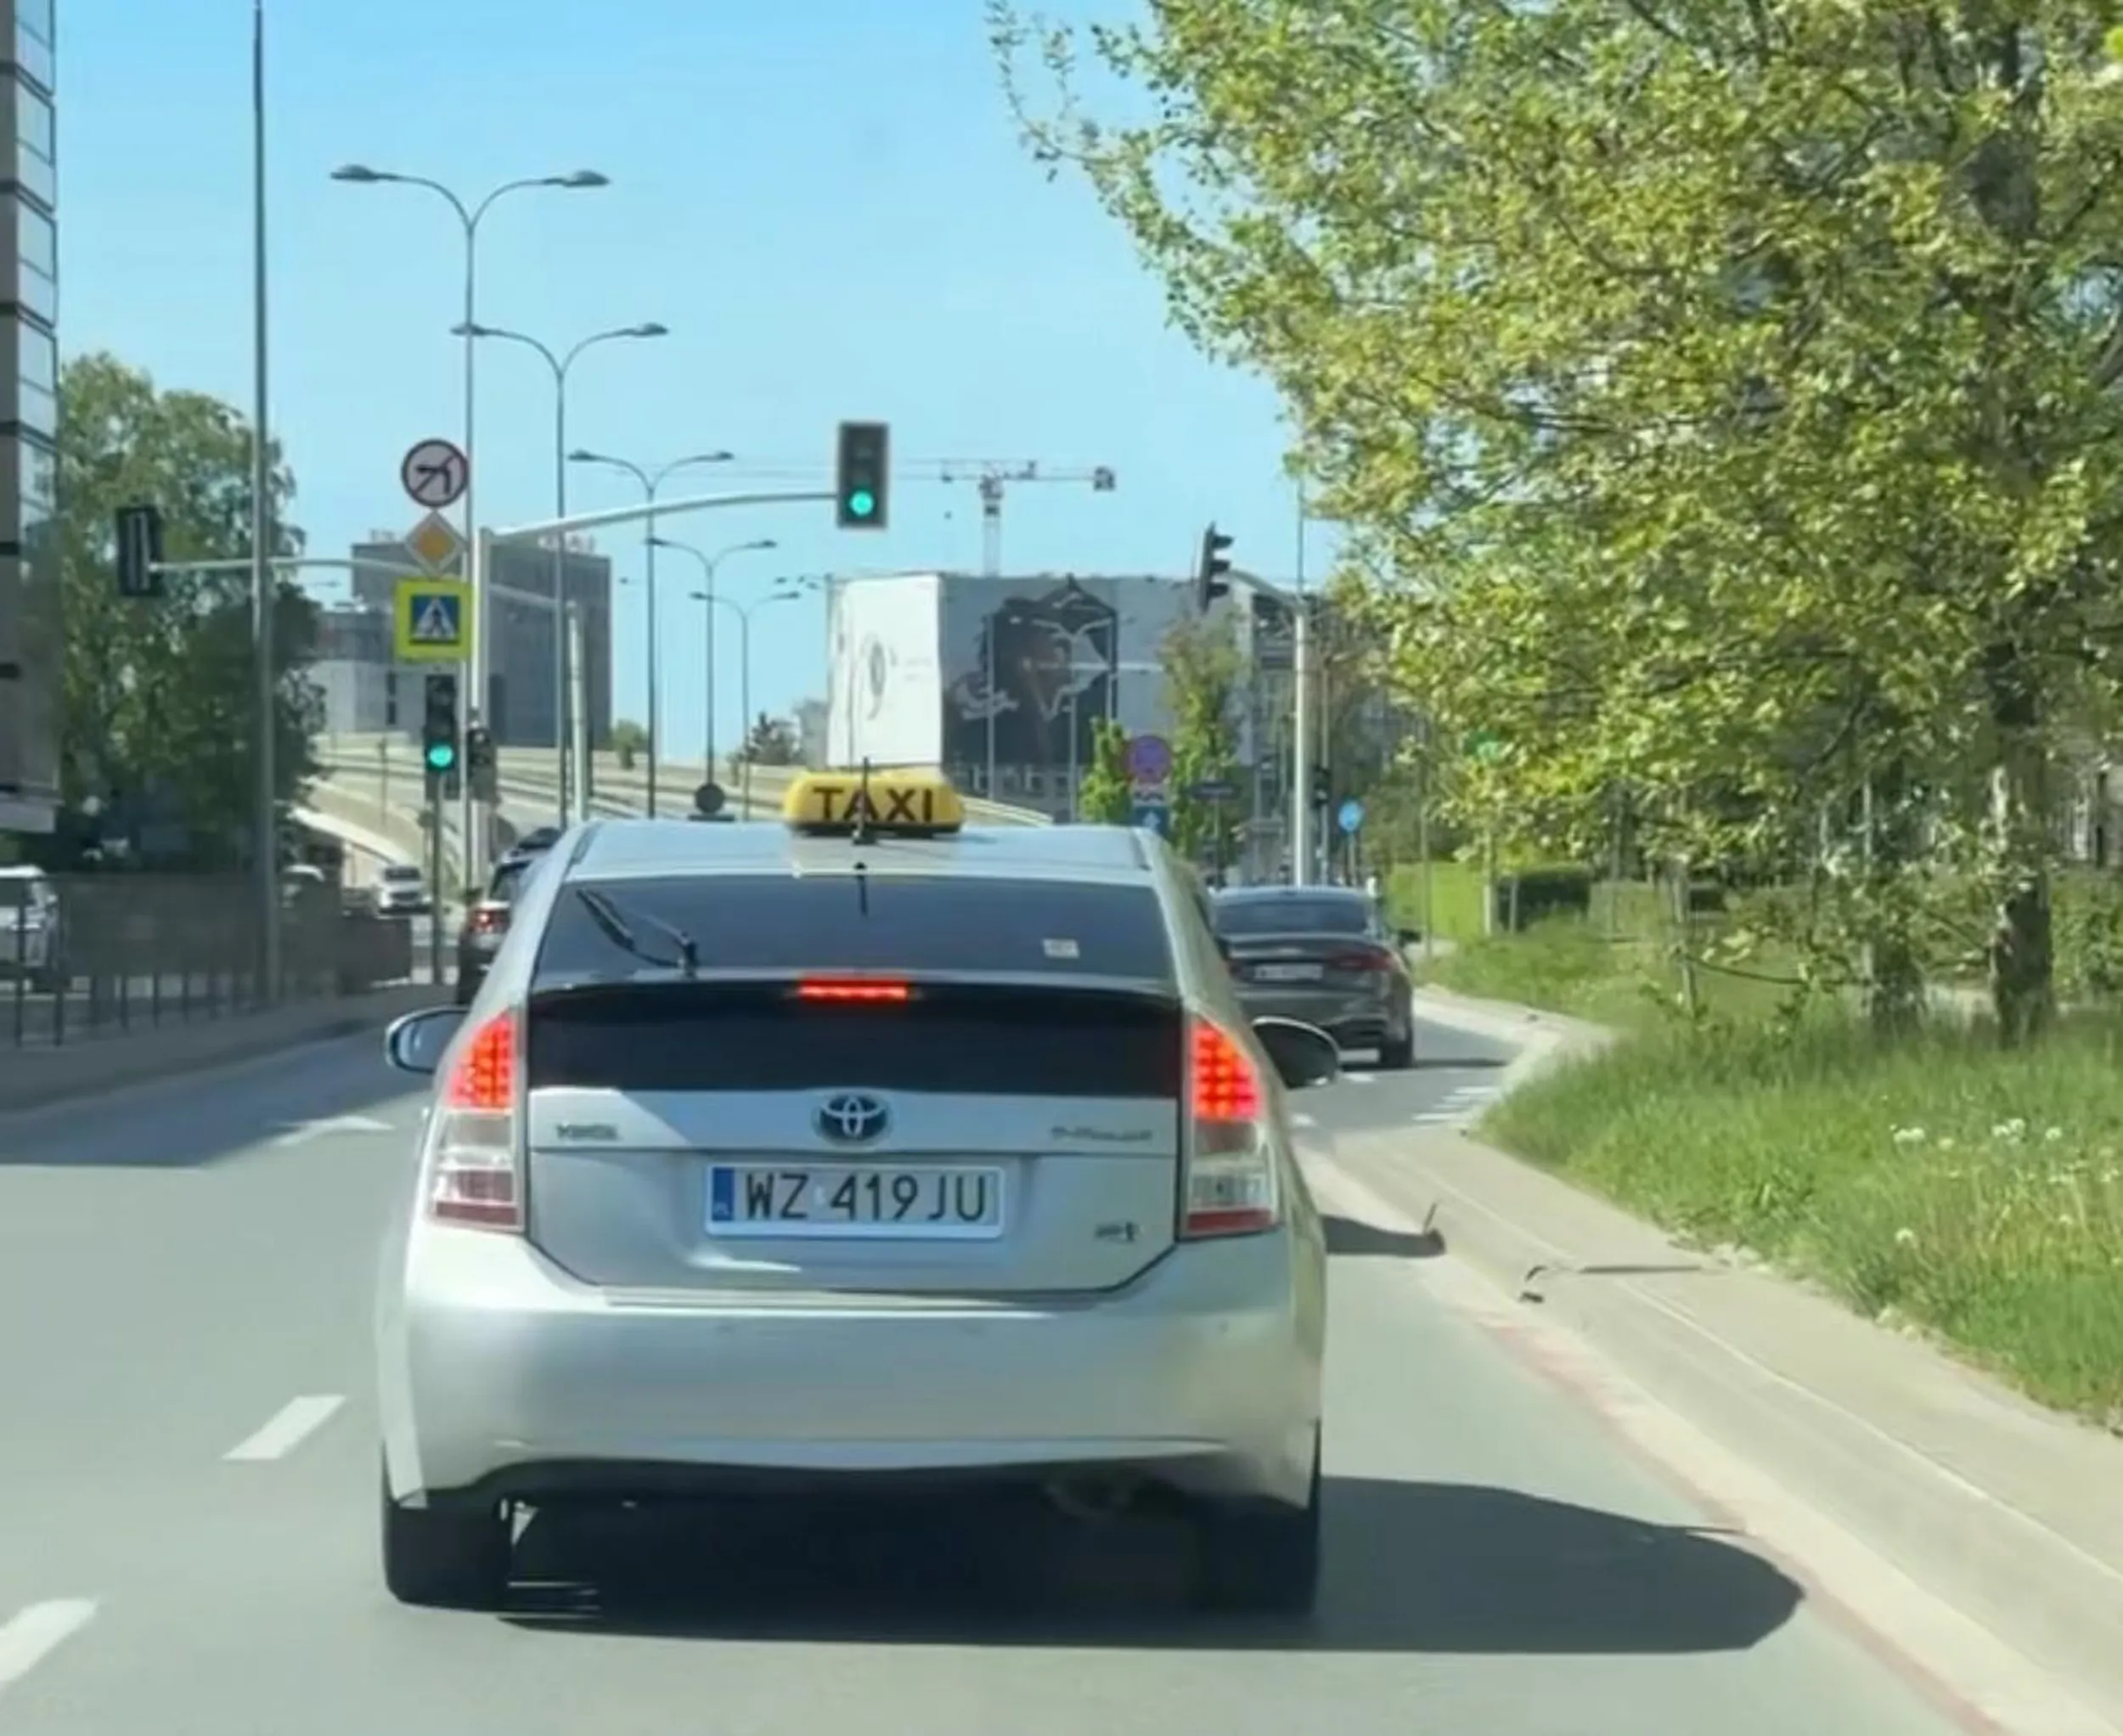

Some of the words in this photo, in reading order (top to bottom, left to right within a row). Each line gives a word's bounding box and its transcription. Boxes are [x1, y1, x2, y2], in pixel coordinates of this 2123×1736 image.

[813, 786, 933, 822] TAXI
[745, 1172, 809, 1220] WZ
[829, 1173, 987, 1222] 419JU
